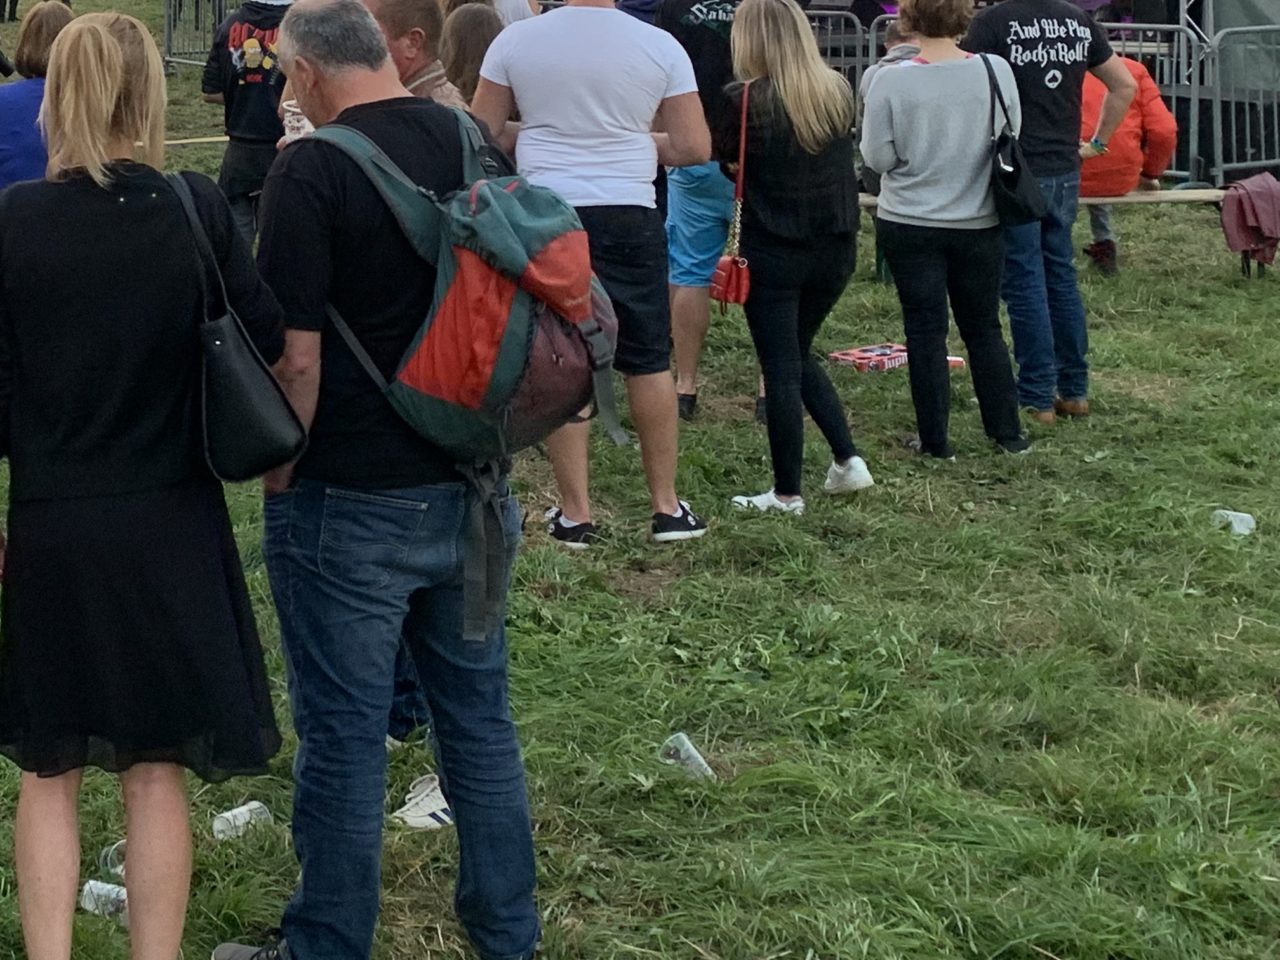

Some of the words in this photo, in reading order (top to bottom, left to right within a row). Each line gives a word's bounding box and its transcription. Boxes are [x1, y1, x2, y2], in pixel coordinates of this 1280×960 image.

[1007, 18, 1041, 44] And
[1041, 18, 1068, 38] We
[1066, 18, 1092, 43] Play
